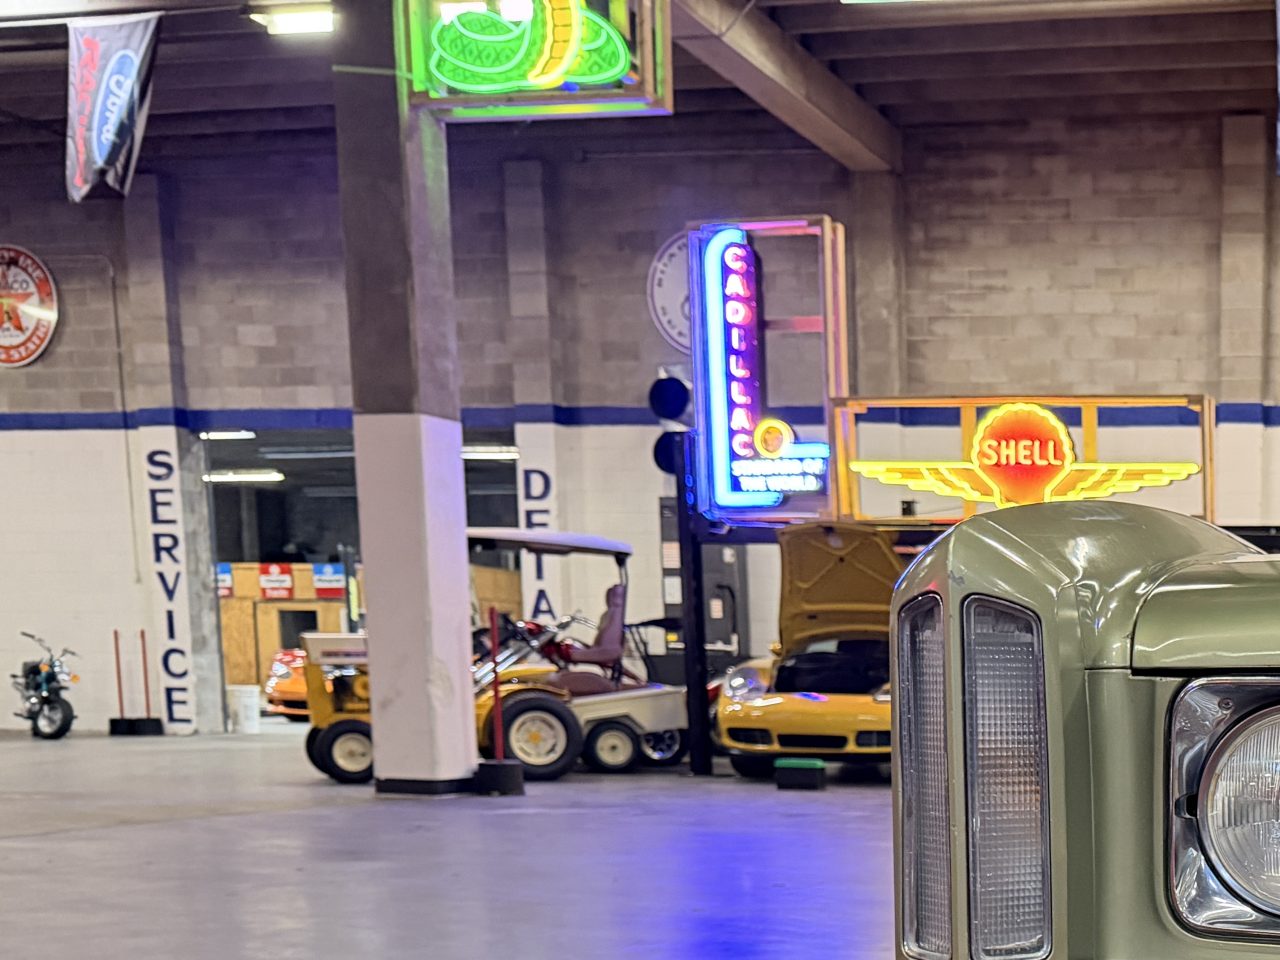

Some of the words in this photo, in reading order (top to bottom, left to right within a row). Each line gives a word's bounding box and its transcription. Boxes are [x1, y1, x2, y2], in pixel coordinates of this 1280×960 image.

[101, 73, 133, 145] Ford
[724, 246, 755, 457] CADILLAC
[982, 439, 1063, 466] SHELL
[147, 450, 192, 724] SERVICE
